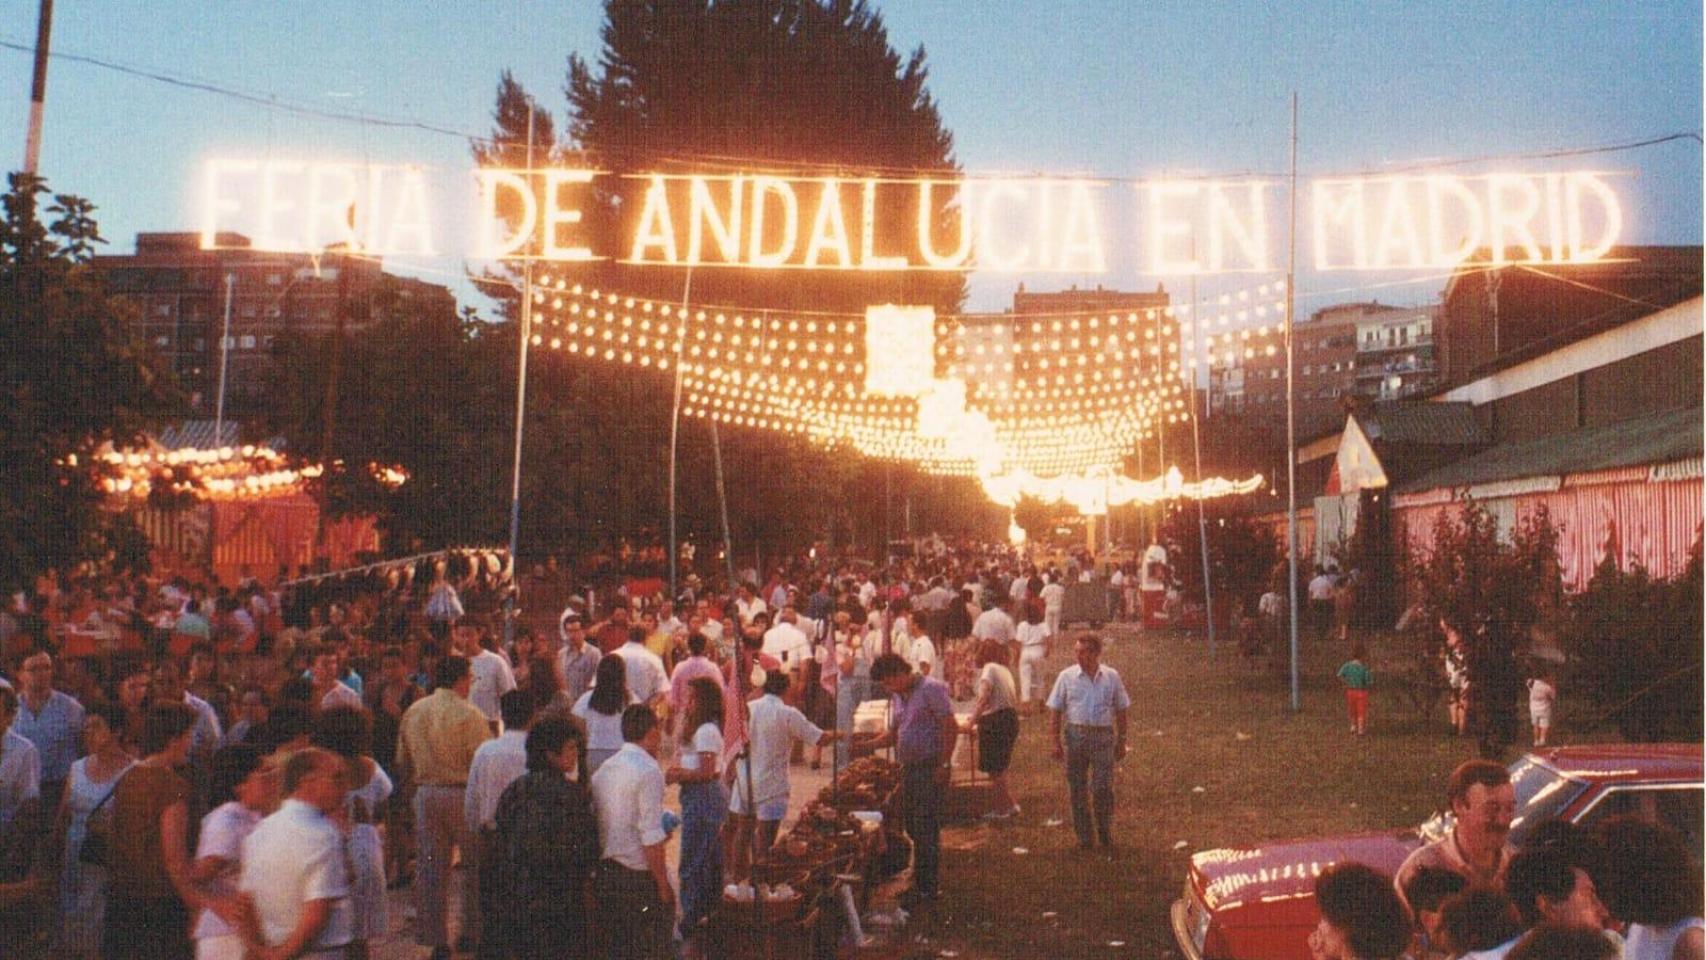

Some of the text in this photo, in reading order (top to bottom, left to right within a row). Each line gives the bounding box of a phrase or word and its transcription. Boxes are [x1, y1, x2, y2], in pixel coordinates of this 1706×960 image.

[201, 159, 435, 254] FERIA
[481, 169, 594, 260] DE
[1148, 178, 1270, 272] EN
[1313, 171, 1623, 270] MADRID
